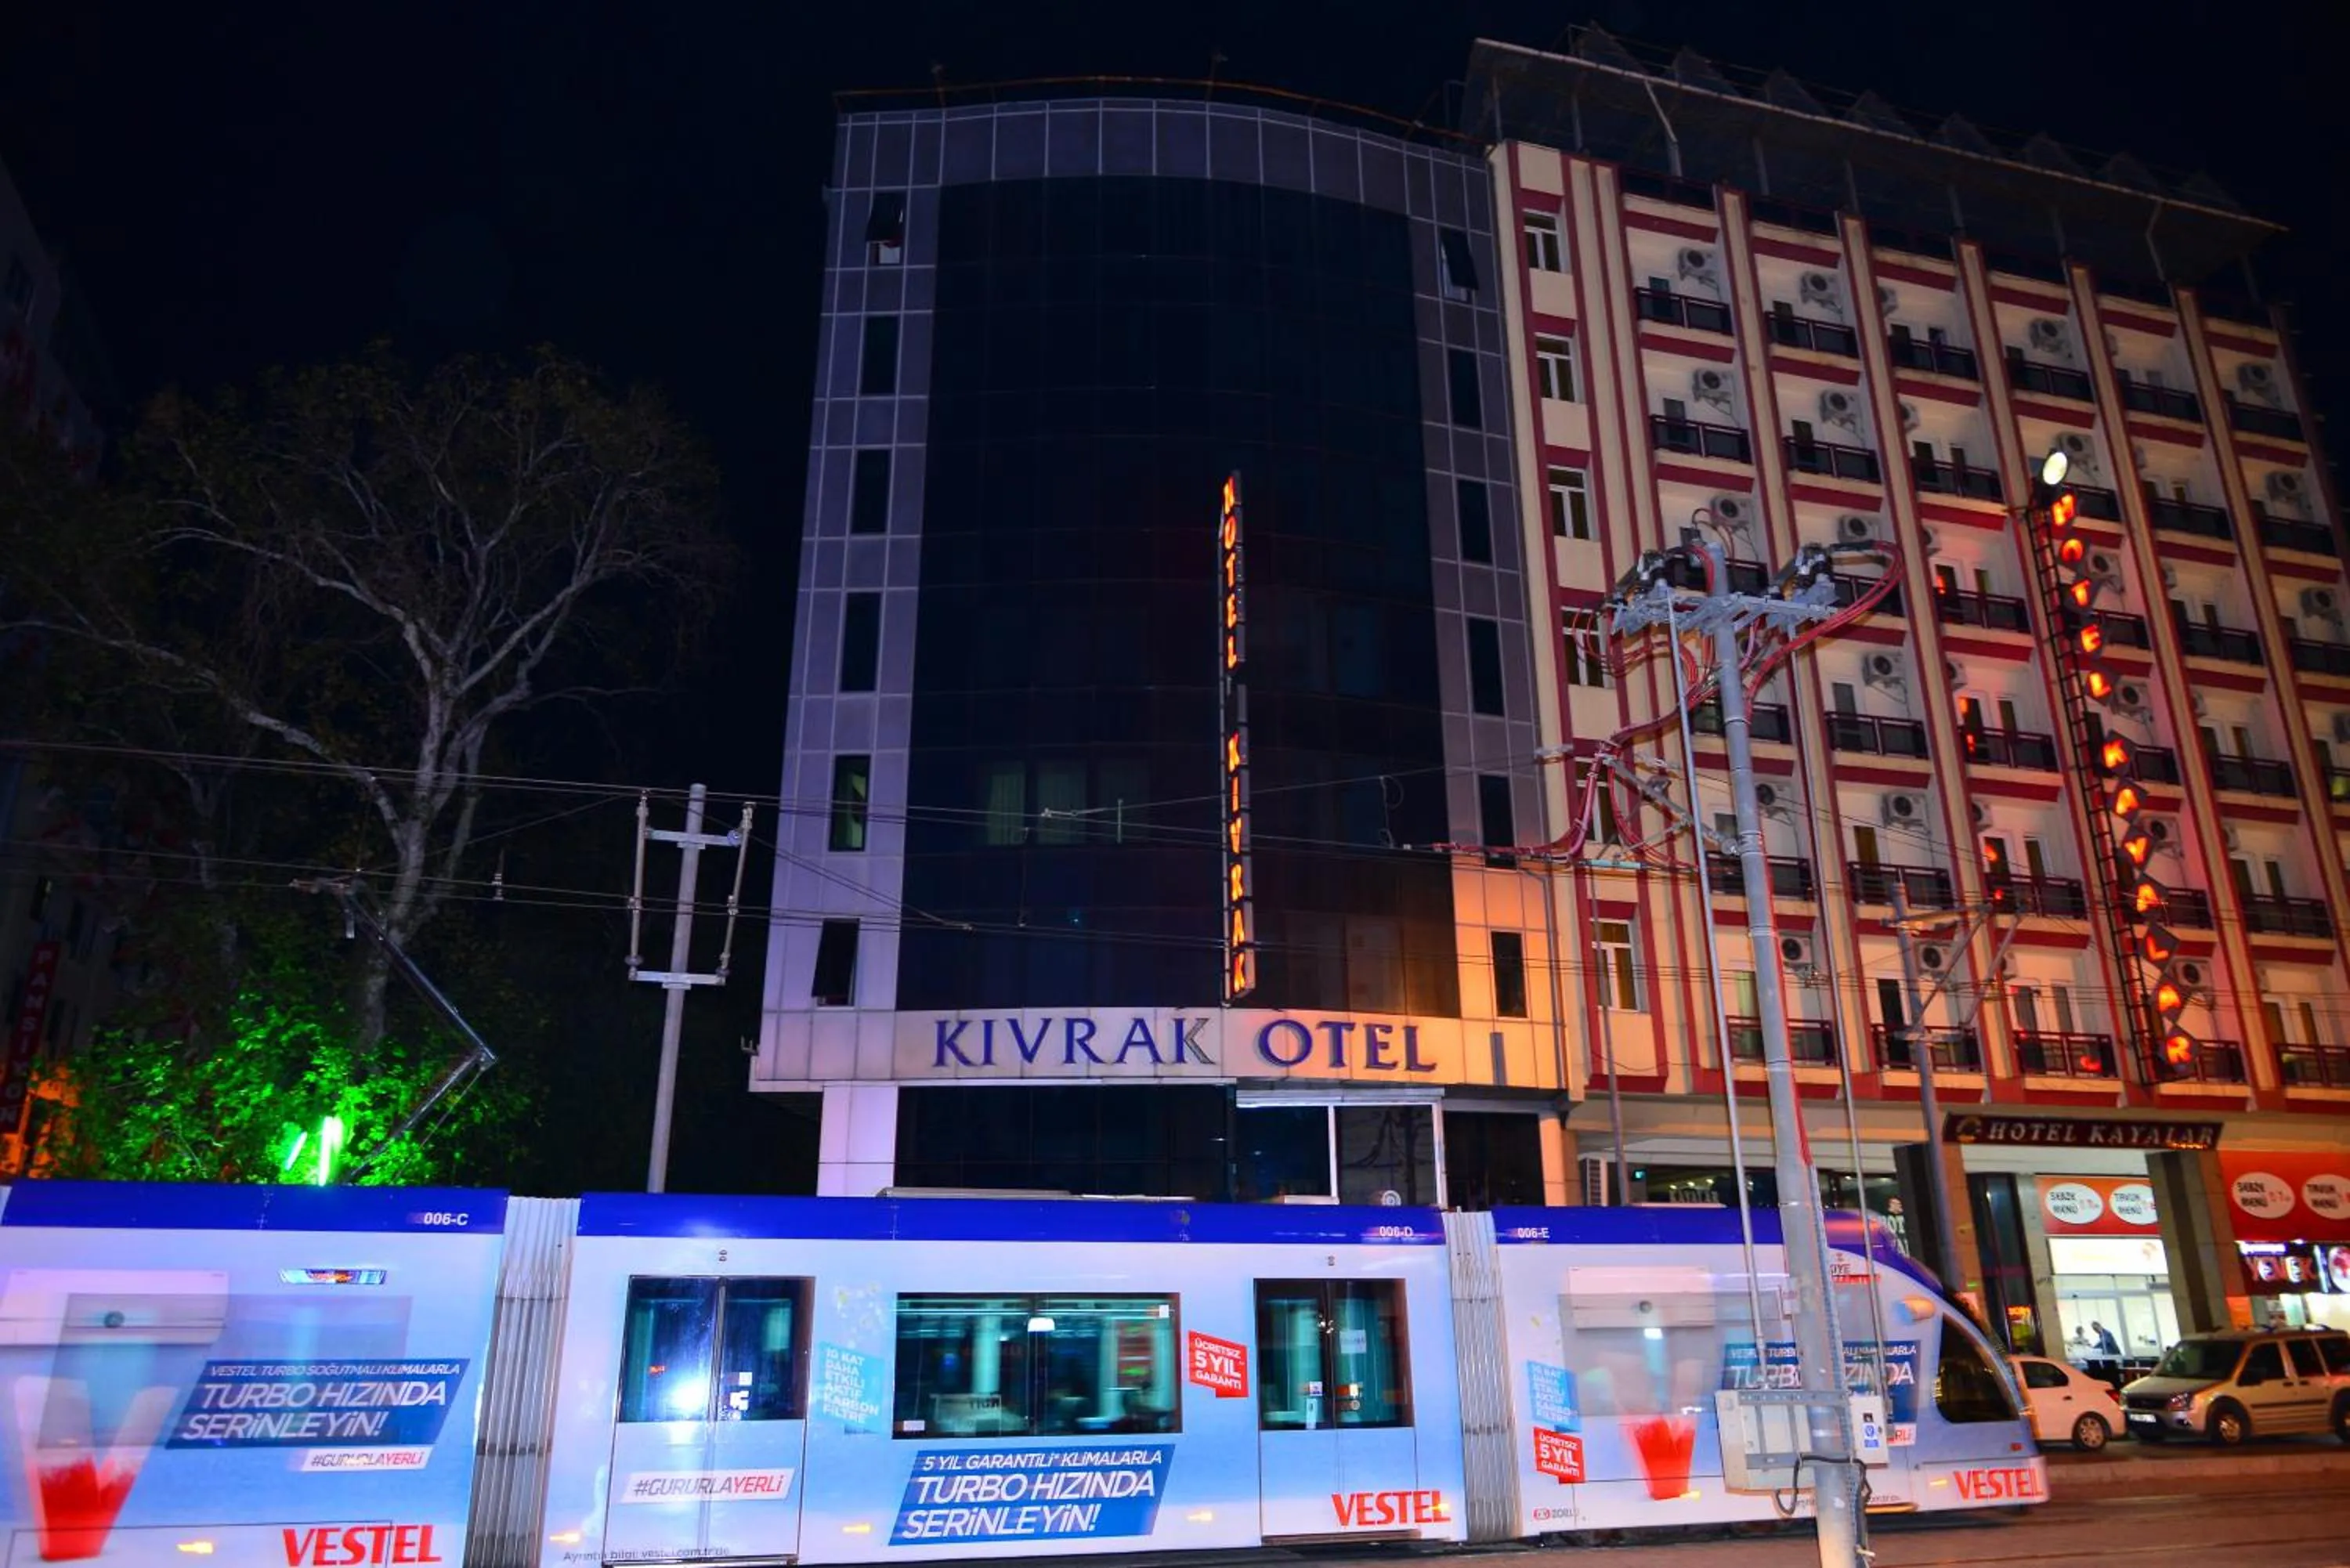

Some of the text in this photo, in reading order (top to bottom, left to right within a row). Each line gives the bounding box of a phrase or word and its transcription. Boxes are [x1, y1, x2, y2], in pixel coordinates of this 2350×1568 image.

[2052, 493, 2113, 698] HOTEL
[2102, 739, 2192, 1064] KAYALAR
[935, 1018, 1437, 1073] KIVRAK OTEL
[1988, 1121, 2214, 1148] HOTEL KAYALAR
[423, 1212, 470, 1227] 006-C
[1517, 1227, 1550, 1239] 006-E
[1195, 1349, 1207, 1369] 5
[201, 1380, 446, 1410] TURBO HIZINDA
[923, 1455, 935, 1472] 5
[938, 1454, 963, 1471] YIL
[1539, 1443, 1551, 1460] 5
[916, 1469, 1156, 1505] TURBO HIZINDA
[1953, 1467, 2044, 1501] VESTEL
[1331, 1490, 1452, 1527] VESTEL
[282, 1524, 443, 1567] VESTEL
